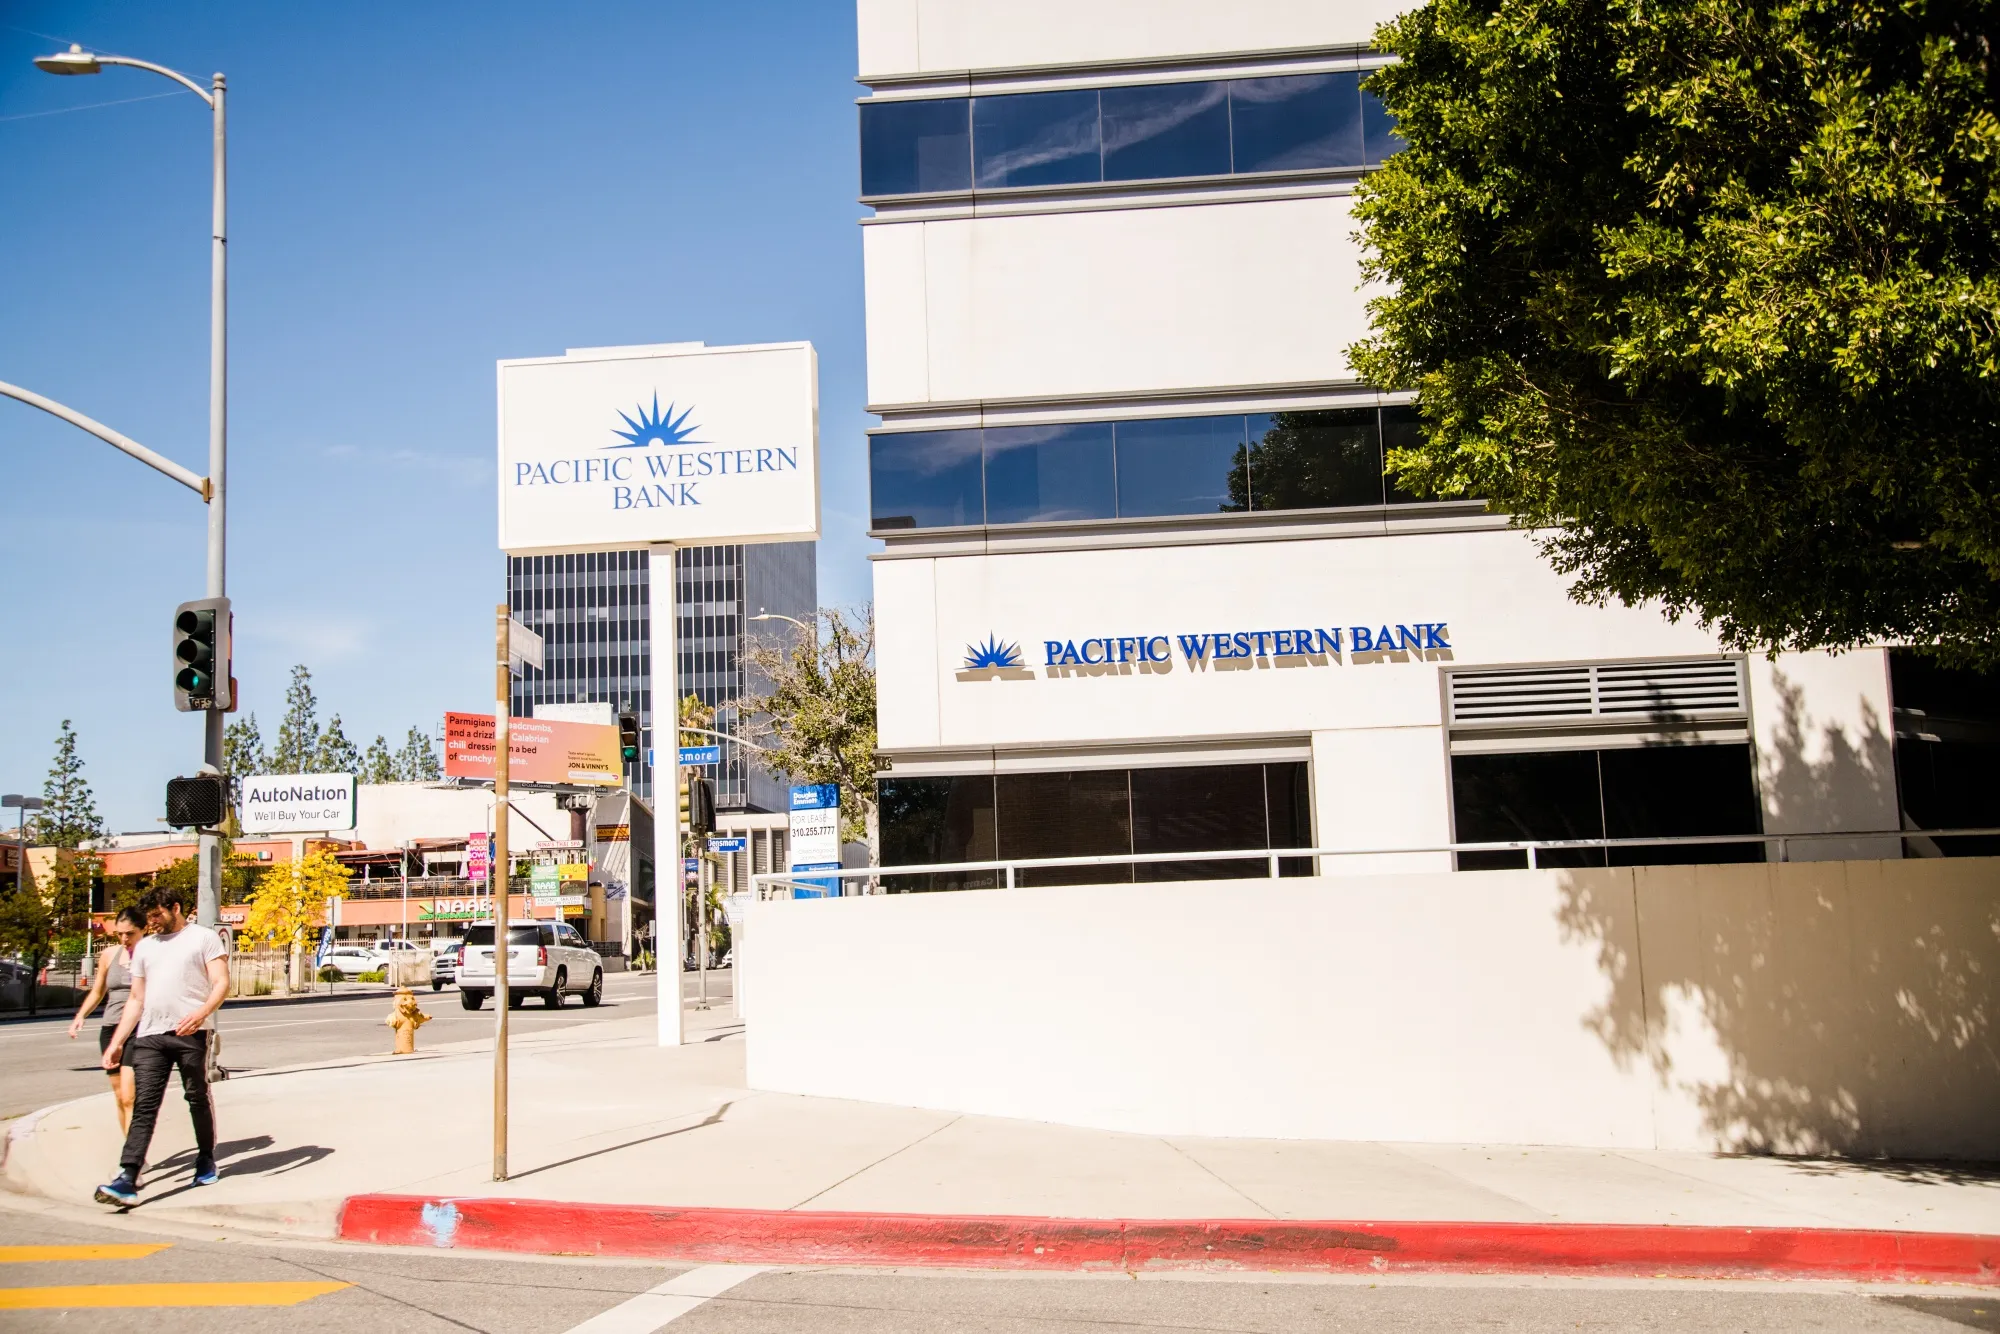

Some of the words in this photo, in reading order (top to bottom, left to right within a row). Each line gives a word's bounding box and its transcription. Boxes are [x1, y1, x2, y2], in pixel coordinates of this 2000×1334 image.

[514, 456, 633, 486] PACIFIC
[645, 446, 799, 479] WESTERN
[613, 482, 702, 511] BANK
[1043, 635, 1171, 667] PACIFIC
[1177, 627, 1343, 660] WESTERN
[1350, 622, 1452, 653] BANK
[449, 716, 496, 728] Parmigiano
[508, 720, 553, 733] eadcrumbs,
[449, 729, 465, 737] and
[473, 730, 496, 739] drizzl
[511, 733, 549, 744] Calabrian
[448, 740, 466, 749] chili
[468, 742, 497, 751] dressin
[521, 745, 537, 754] bed
[458, 754, 492, 765] crunchy
[493, 757, 528, 766] raine.
[679, 752, 713, 762] smore
[586, 763, 609, 771] VINNY'S
[249, 786, 347, 803] AutoNation
[793, 797, 818, 805] Emmett
[254, 811, 276, 821] We'll
[278, 810, 297, 821] Buy
[299, 810, 320, 819] Your
[323, 809, 340, 819] Car
[792, 815, 806, 824] FOR
[807, 814, 827, 823] LEASE
[792, 826, 835, 837] 310.255.7777
[708, 839, 739, 847] Densmore
[534, 881, 557, 890] NAAB
[434, 899, 493, 913] NAAB
